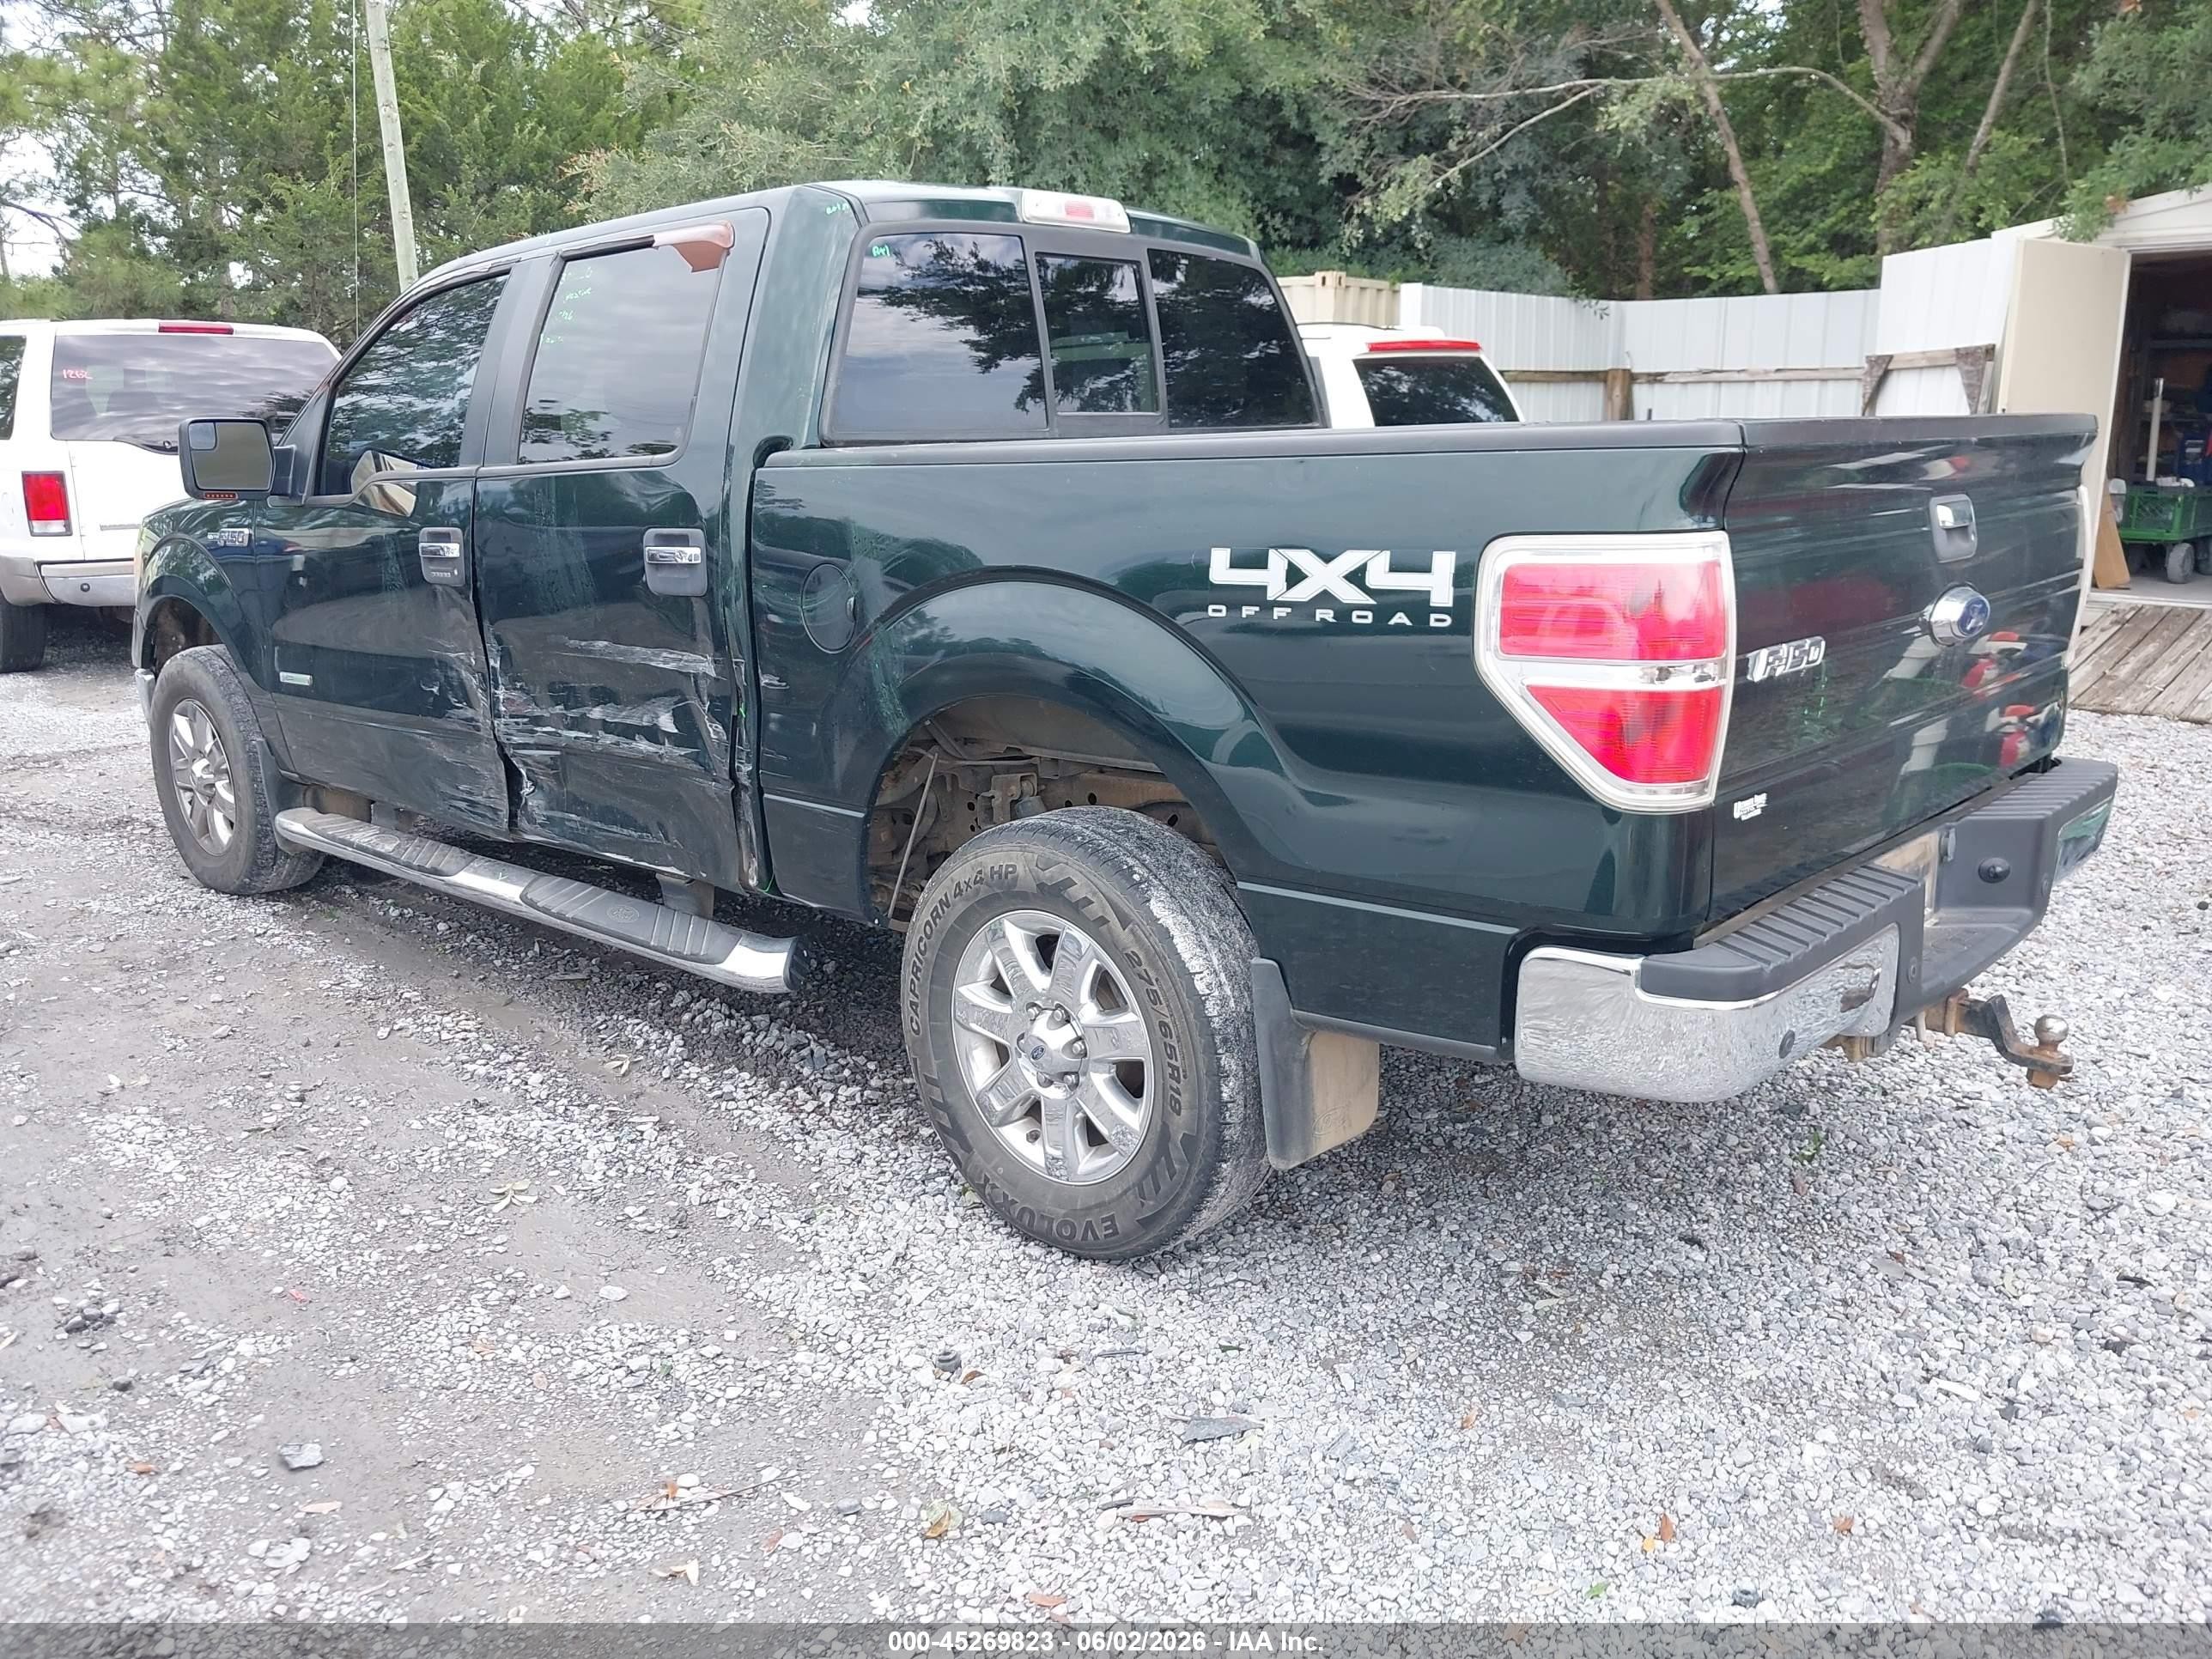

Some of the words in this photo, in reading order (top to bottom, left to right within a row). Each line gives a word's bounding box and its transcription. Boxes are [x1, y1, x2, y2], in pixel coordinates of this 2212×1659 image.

[1208, 546, 1456, 607] 4X4
[1206, 604, 1293, 620] OFF
[1314, 608, 1453, 628] ROAD
[908, 890, 952, 1037] CAPRICORN
[988, 864, 1018, 881] HP
[1124, 949, 1183, 1118] 275/65R18
[974, 1173, 1121, 1243] EVOLUXX
